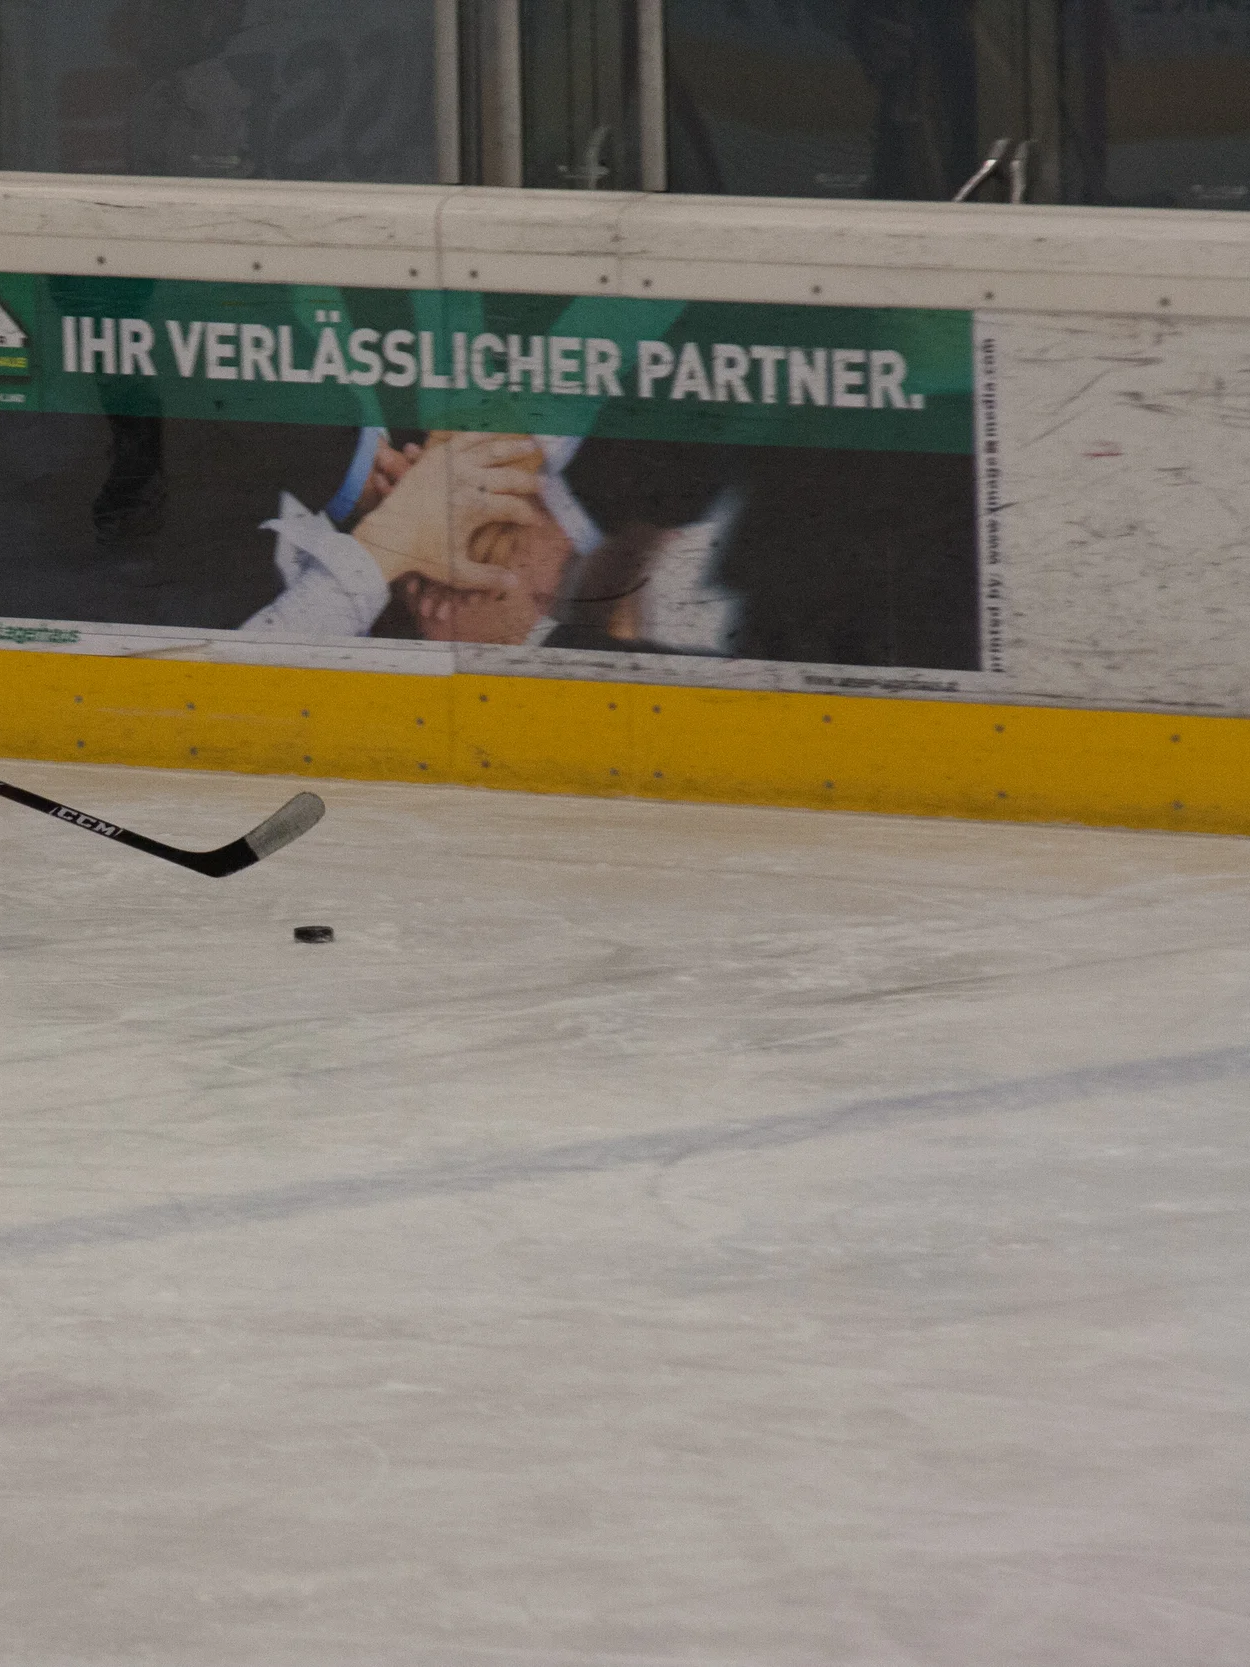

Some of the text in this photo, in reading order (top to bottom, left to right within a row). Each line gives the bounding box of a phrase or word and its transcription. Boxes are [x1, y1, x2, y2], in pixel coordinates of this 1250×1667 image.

[61, 309, 926, 411] IHR VERLÄSSLICHER PARTNER.
[56, 806, 117, 838] CCM
